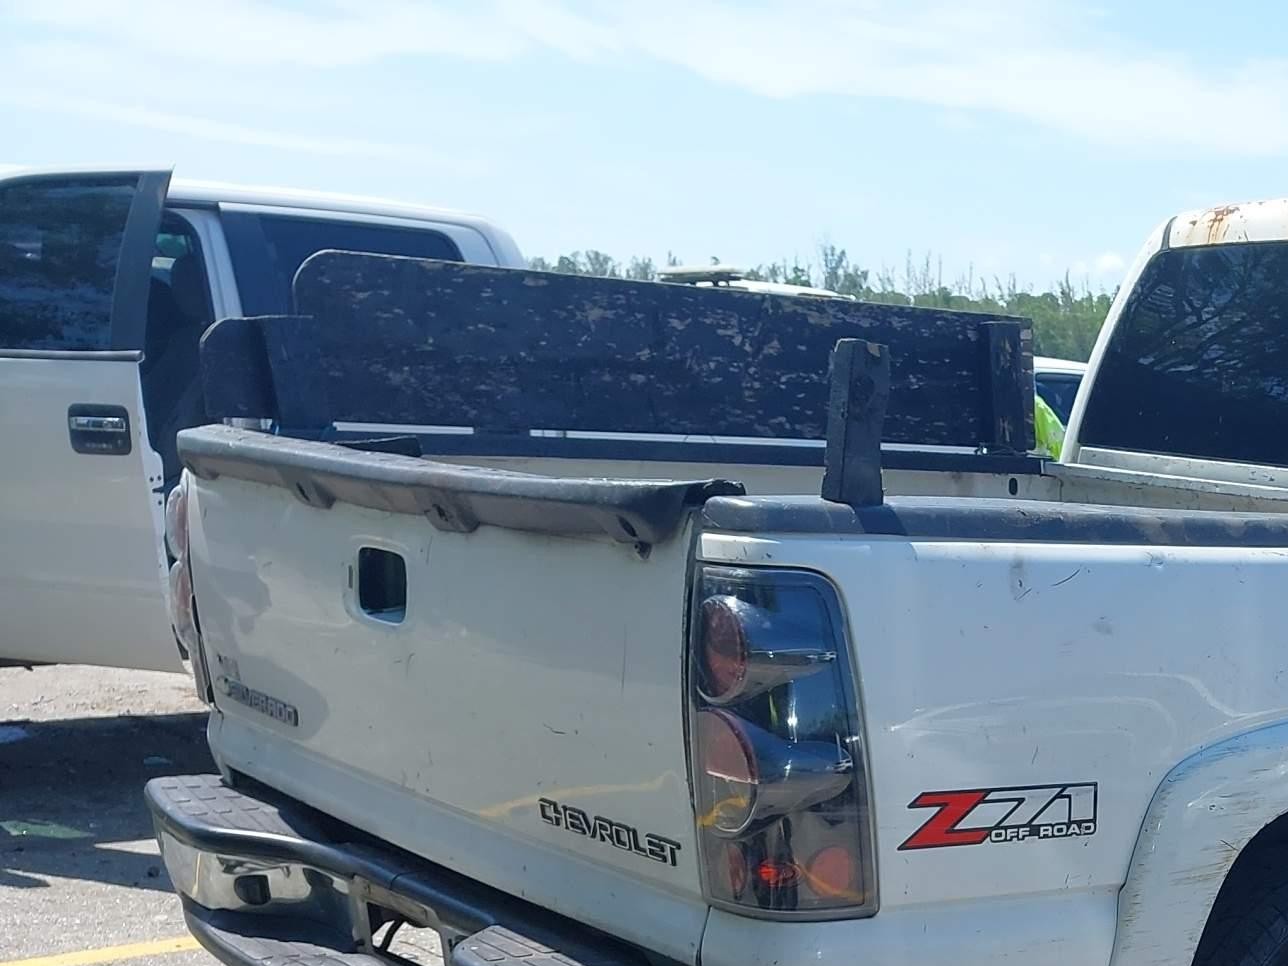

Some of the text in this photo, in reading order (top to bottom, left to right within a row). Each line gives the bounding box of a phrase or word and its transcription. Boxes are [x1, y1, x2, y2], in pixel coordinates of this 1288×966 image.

[538, 797, 682, 867] CHEVROLET
[897, 782, 1098, 851] Z71
[990, 822, 1095, 843] OFF ROAD
